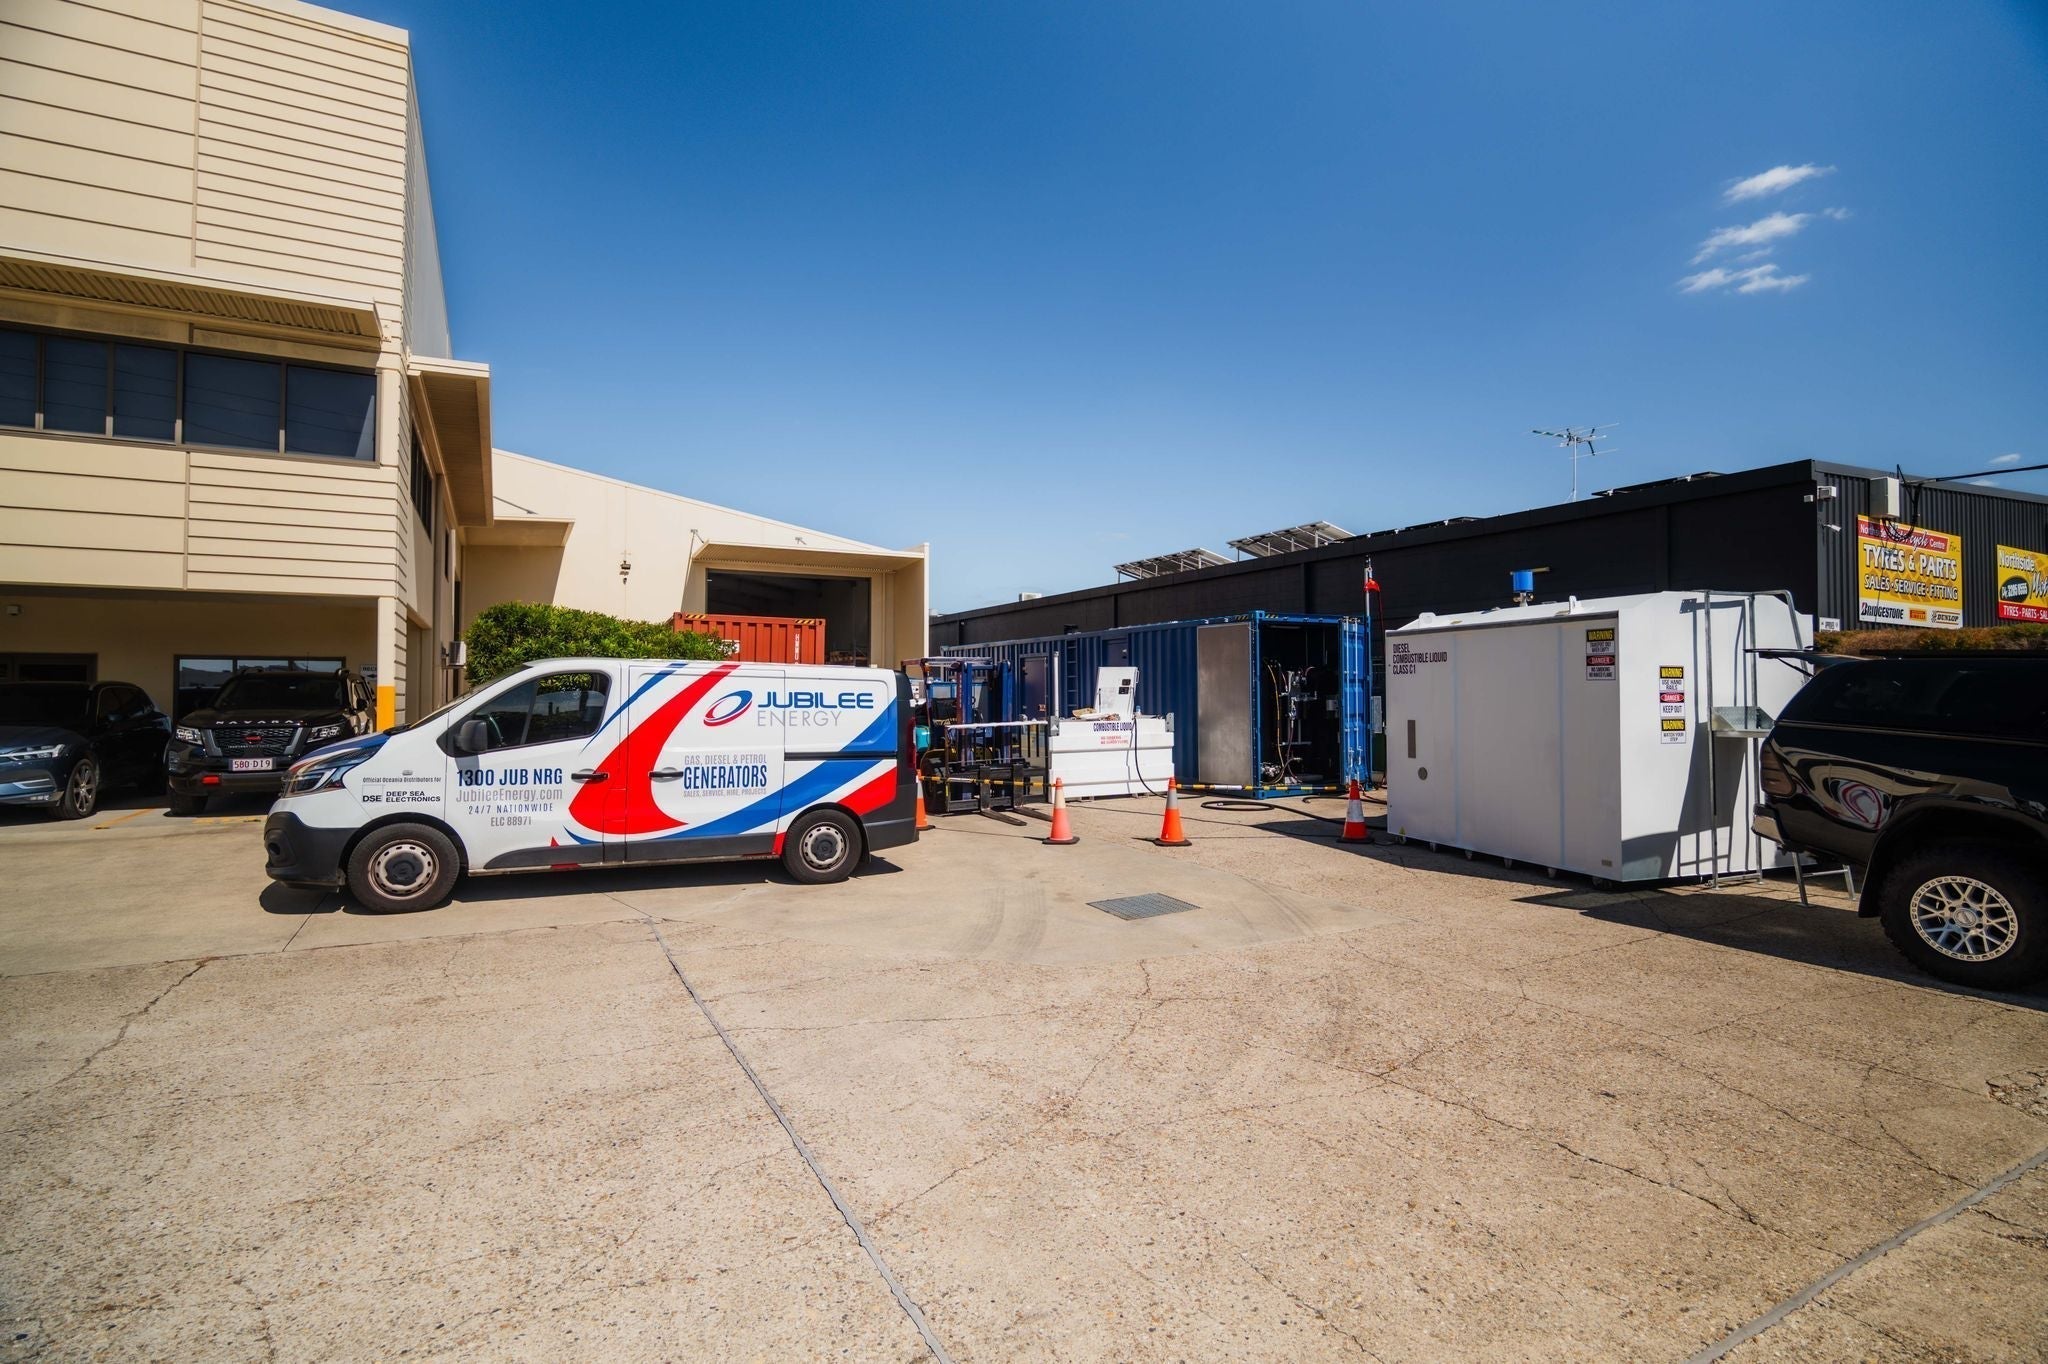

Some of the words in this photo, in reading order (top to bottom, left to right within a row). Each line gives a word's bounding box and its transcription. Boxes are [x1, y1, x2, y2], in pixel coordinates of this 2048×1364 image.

[1864, 544, 1905, 572] TYRES
[1908, 554, 1916, 572] &
[1919, 554, 1957, 580] PARTS
[1999, 551, 2035, 572] Northside
[1864, 575, 1890, 592] SALES
[1894, 579, 1926, 597] SERVICE
[1930, 584, 1958, 601] FITTING
[1861, 602, 1904, 619] BRIDGESTONE
[2003, 606, 2019, 617] TYRES
[2022, 608, 2037, 619] PARTS
[1937, 614, 1959, 622] DUNLOP
[1588, 630, 1613, 641] WARNING
[1393, 643, 1410, 653] DIESEL
[1393, 653, 1428, 664] COMBUSTIBLE
[1429, 652, 1448, 663] LIQUID
[1393, 664, 1408, 675] CLASS
[1661, 668, 1683, 678] WARNING
[757, 691, 874, 709] JUBILEE
[1674, 705, 1683, 713] OUT
[757, 711, 843, 727] ENERGY
[1663, 720, 1685, 730] WARNING
[1093, 722, 1119, 732] COMBUSTIBLE
[1120, 722, 1133, 731] LIQUID
[684, 755, 703, 766] GAS,
[705, 754, 730, 765] DIESEL
[733, 754, 738, 764] &
[740, 754, 767, 764] PETROL
[457, 769, 495, 787] 1300
[499, 768, 528, 786] JUB
[533, 768, 563, 785] NRG
[684, 765, 767, 790] GENERATORS
[456, 788, 563, 803] JubileeEnergy.com
[741, 788, 767, 796] PROJECTS
[468, 804, 491, 815] 24/7
[496, 803, 553, 814] NATIONWIDE
[490, 817, 505, 827] ELC
[507, 815, 532, 826] 88971
